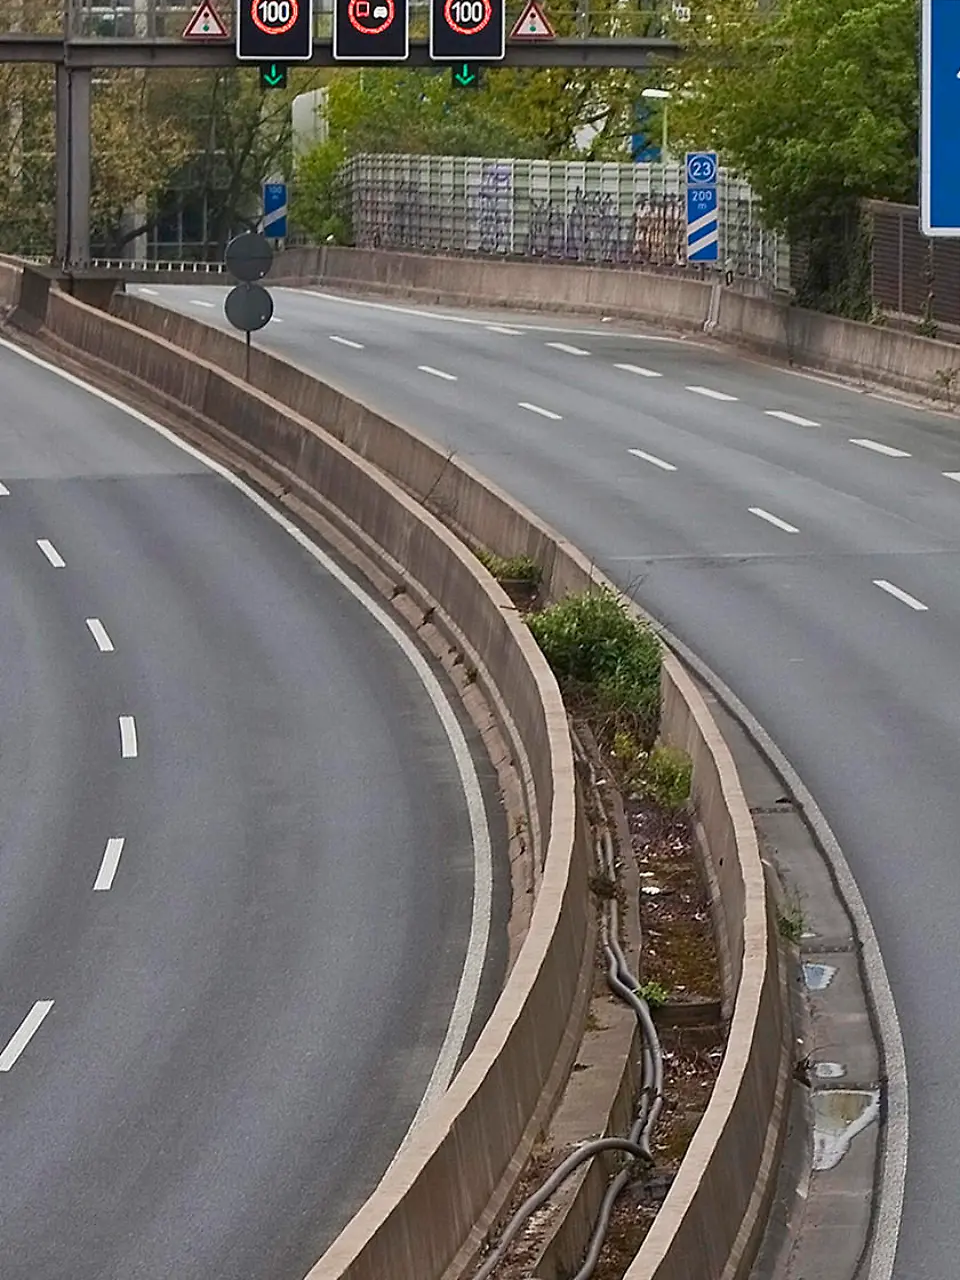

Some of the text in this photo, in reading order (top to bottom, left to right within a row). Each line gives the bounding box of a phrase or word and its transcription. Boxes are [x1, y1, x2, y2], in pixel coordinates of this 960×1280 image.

[258, 0, 290, 23] 100
[451, 0, 483, 23] 100
[692, 161, 712, 176] 23
[692, 190, 713, 202] 200
